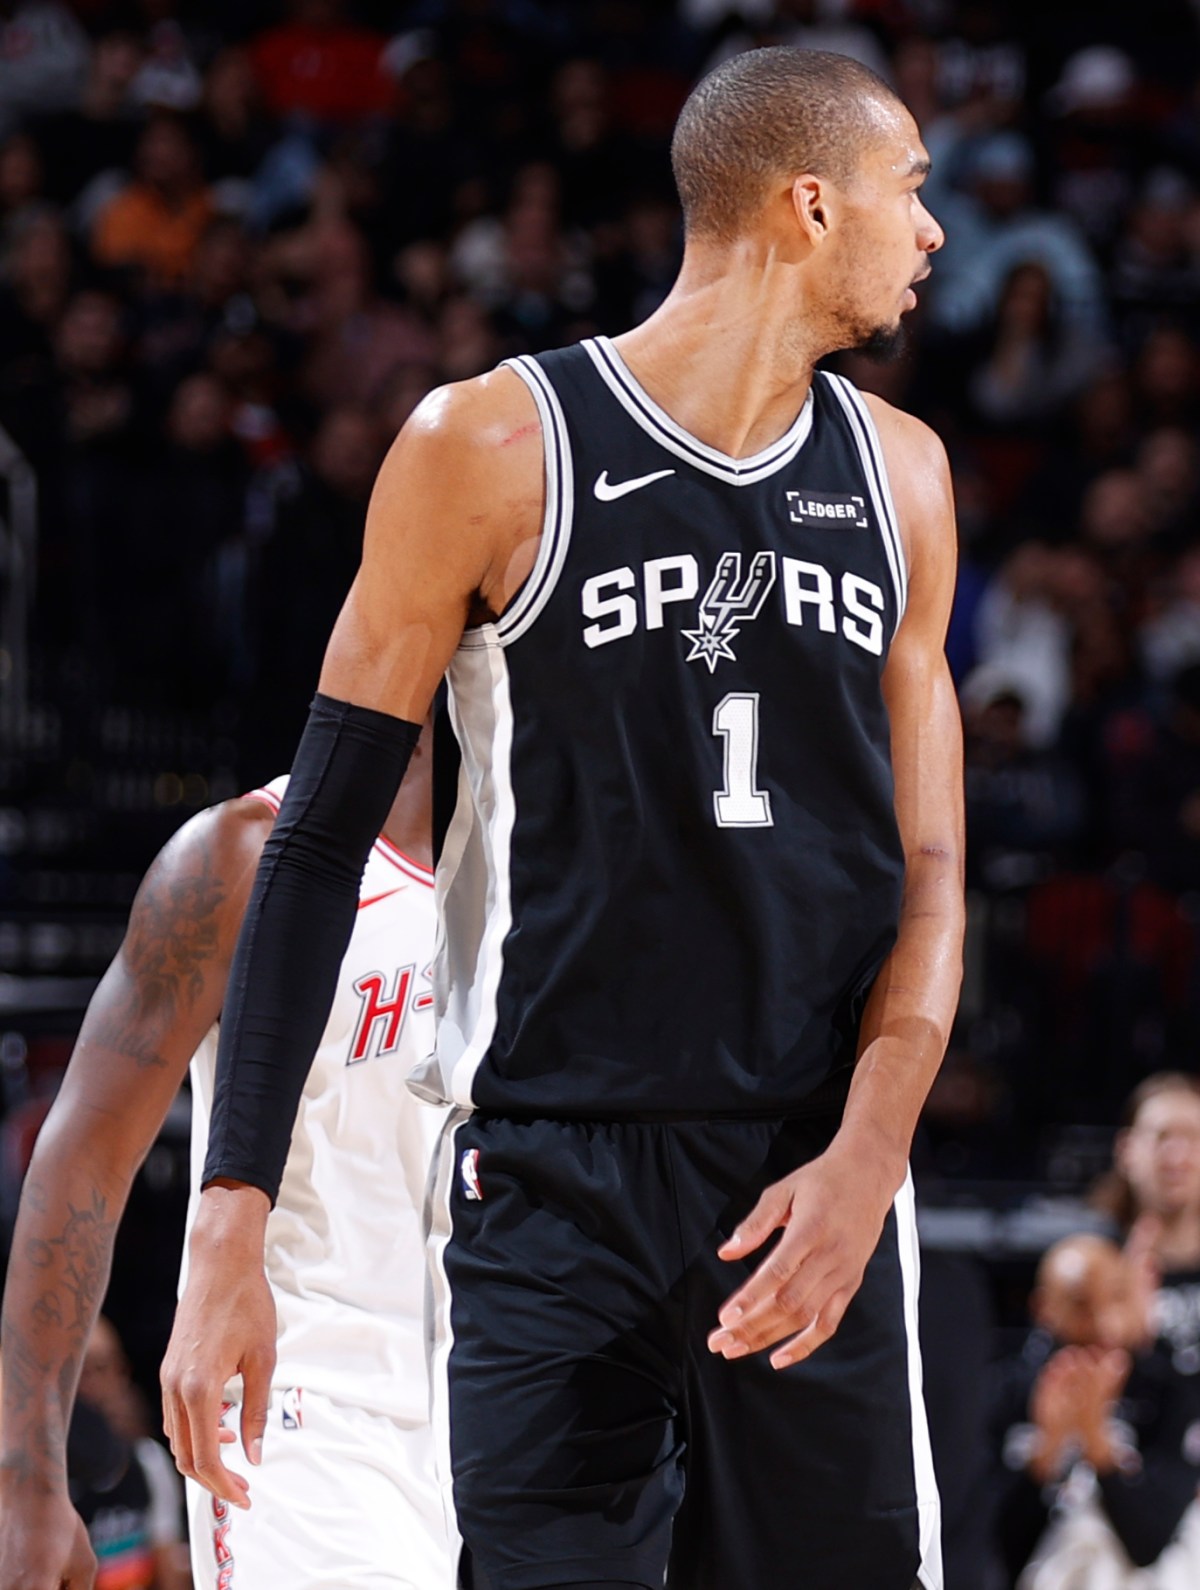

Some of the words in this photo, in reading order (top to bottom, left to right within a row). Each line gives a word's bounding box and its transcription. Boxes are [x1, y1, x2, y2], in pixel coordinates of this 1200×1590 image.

[798, 499, 857, 519] LEDGER
[712, 692, 774, 828] 1
[345, 963, 435, 1067] H-
